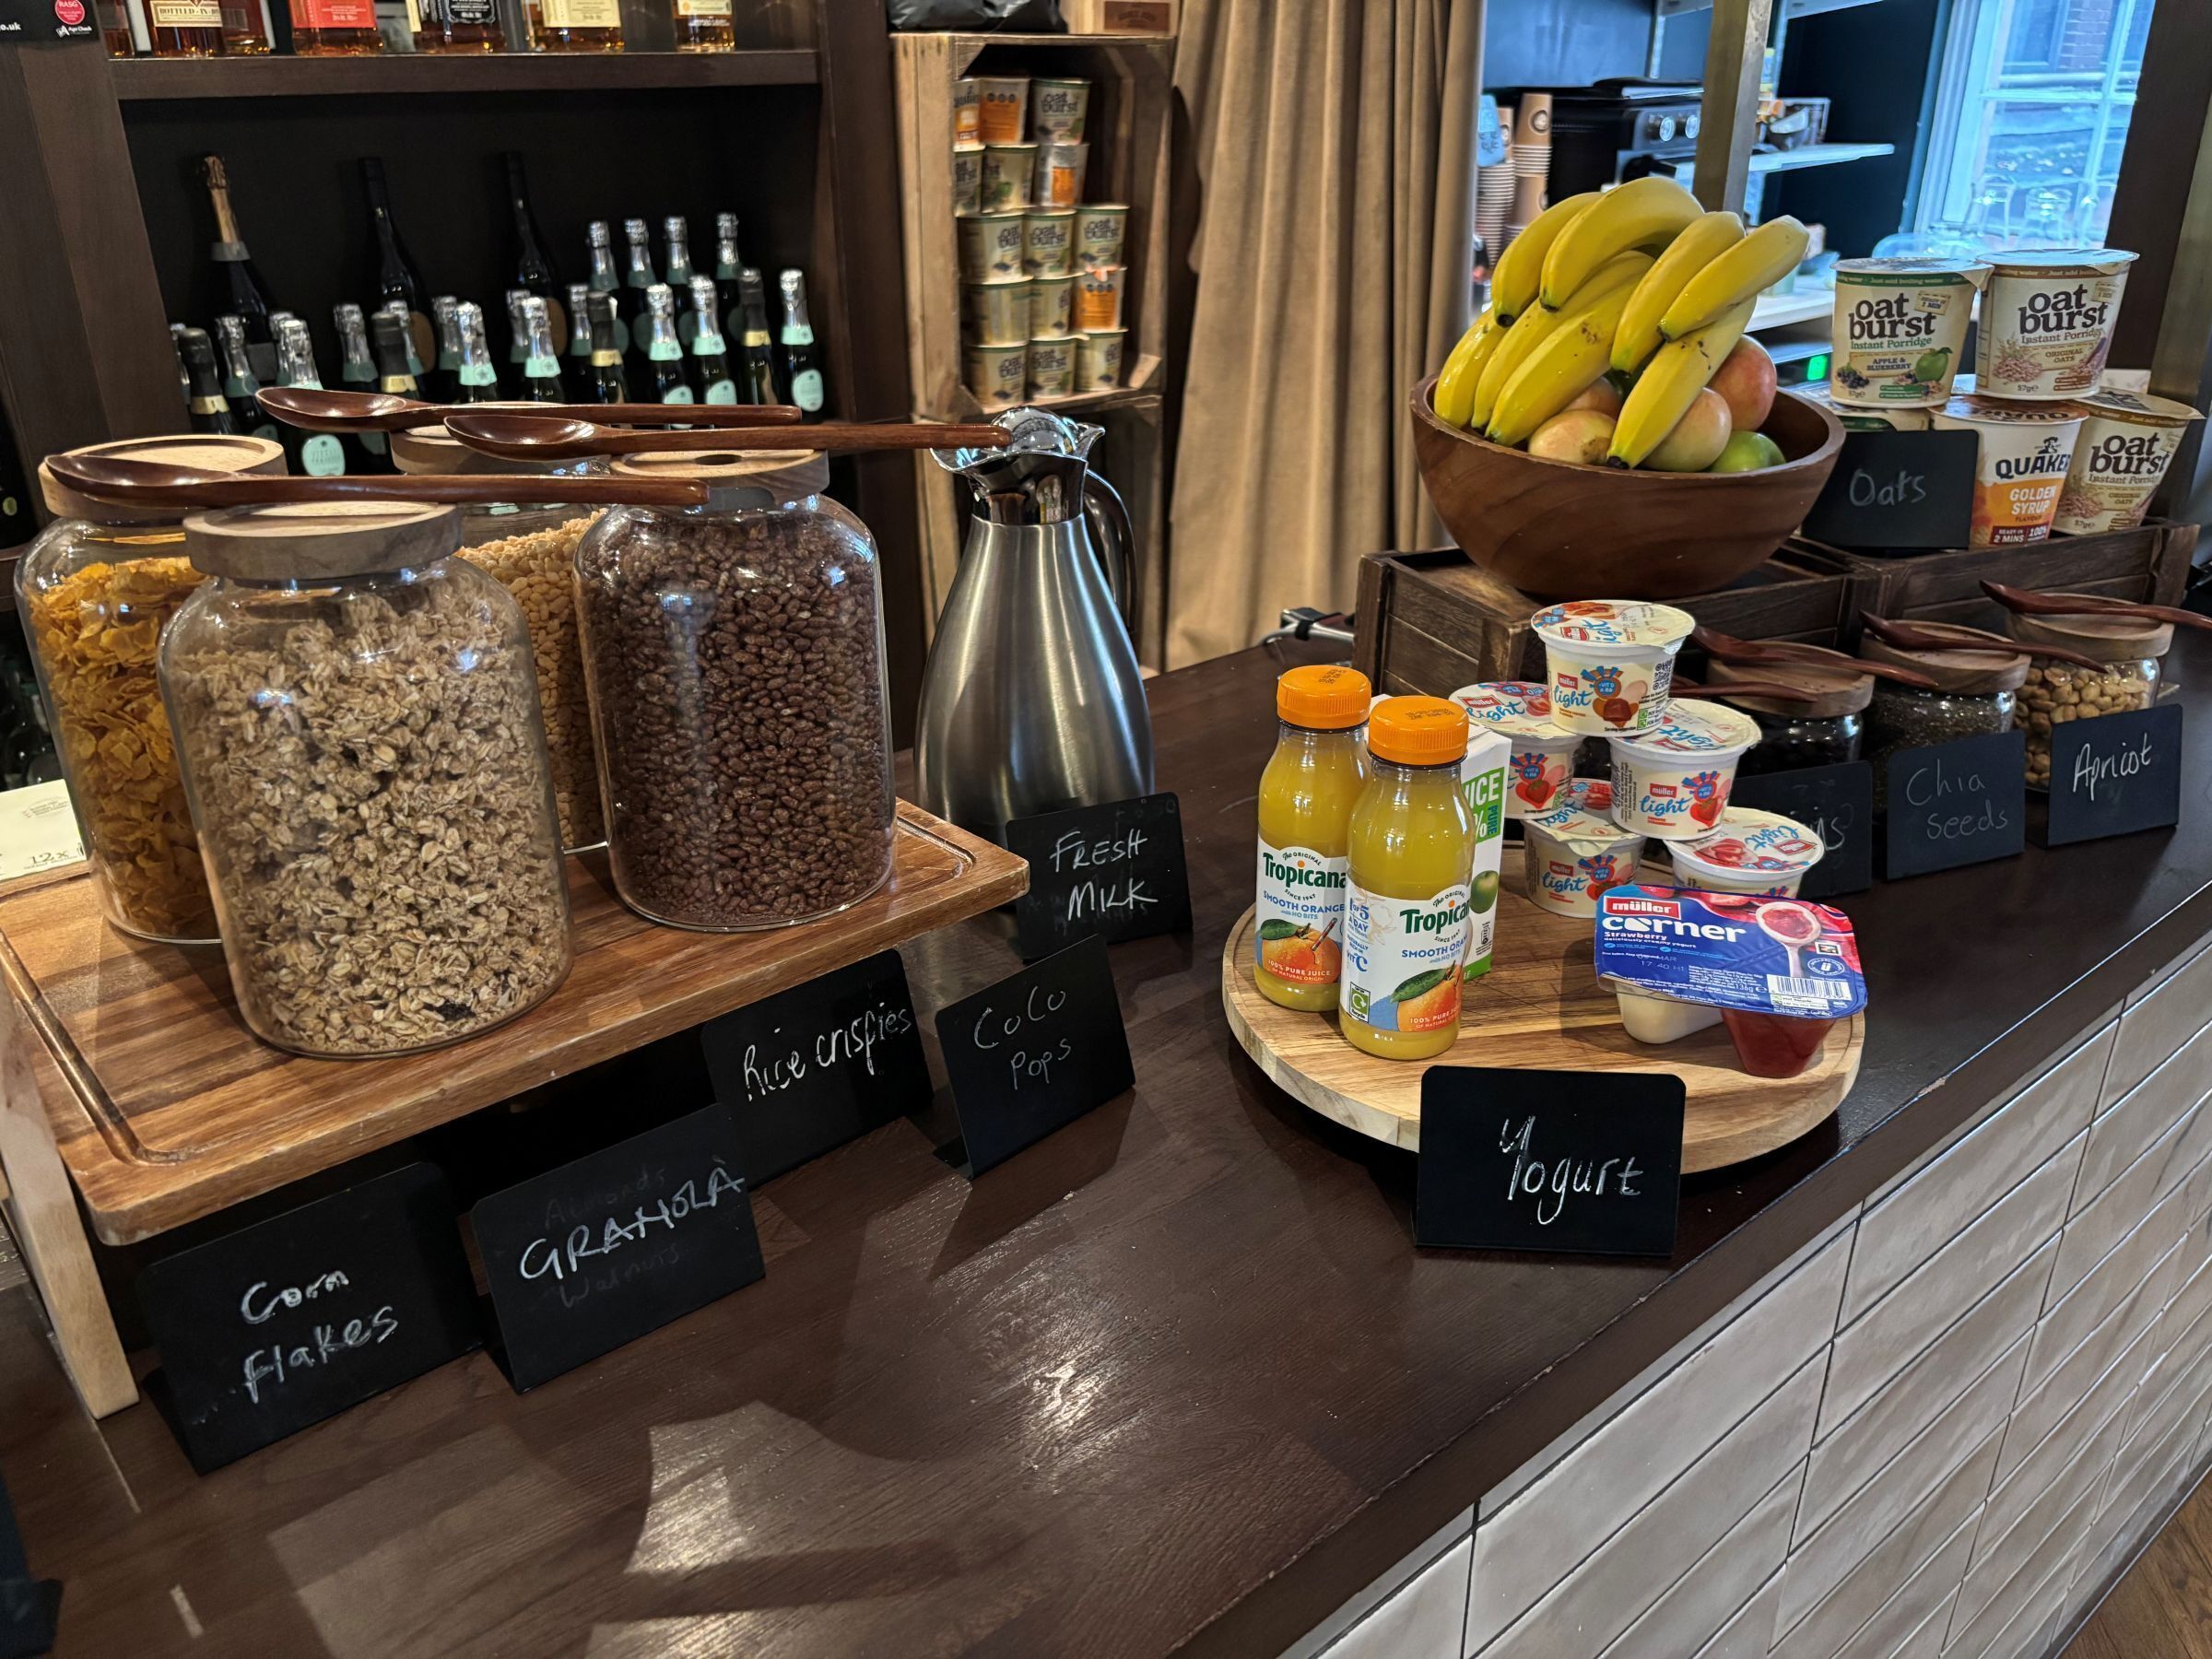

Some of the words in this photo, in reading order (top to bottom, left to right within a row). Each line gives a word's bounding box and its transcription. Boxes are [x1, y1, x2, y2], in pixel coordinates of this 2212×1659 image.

[2029, 283, 2088, 313] oat
[1855, 292, 1910, 321] oat
[1848, 312, 1937, 340] burst
[2018, 302, 2108, 335] burst
[1851, 339, 1884, 350] Instant
[1887, 336, 1933, 348] Porridge
[2021, 334, 2061, 345] Instant
[2045, 348, 2083, 358] ORIGINAL
[1866, 362, 1912, 371] BLUEBERRY
[2103, 432, 2160, 456] oat
[2088, 445, 2170, 476] burst
[1849, 467, 1927, 507] Oats
[2088, 474, 2127, 485] Instant
[2009, 485, 2058, 501] GOLDEN
[2011, 500, 2051, 515] SYRUP
[1993, 535, 2001, 544] 2
[2002, 535, 2025, 543] MINS
[1554, 685, 1594, 708] light
[1465, 700, 1525, 722] light
[2072, 733, 2153, 801] Apricot
[1652, 786, 1675, 795] müller
[1906, 759, 1986, 806] Chia
[1640, 794, 1694, 817] light
[1744, 825, 1800, 851] light
[1049, 825, 1149, 873] FRESH
[1282, 852, 1292, 861] The
[1293, 852, 1322, 866] ORIGINAL
[1263, 852, 1347, 888] Tropicana
[1542, 871, 1590, 893] light
[1066, 877, 1159, 922] MILK
[1264, 890, 1299, 911] SMOOTH
[1300, 903, 1346, 913] ORANGE
[1285, 888, 1301, 900] SINCE
[1302, 893, 1316, 901] 1947
[1433, 897, 1444, 908] The
[1291, 911, 1302, 919] NO
[1359, 905, 1370, 921] 5
[1612, 901, 1672, 913] müller
[1353, 919, 1370, 933] DAY
[1602, 916, 1747, 943] corner
[1604, 931, 1667, 940] Strawberry
[1401, 947, 1448, 958] SMOOTH
[1441, 954, 1451, 963] NO
[1268, 959, 1284, 971] 100%
[1285, 966, 1306, 976] PURE
[1355, 956, 1369, 972] C
[1278, 971, 1303, 981] NATURAL
[1735, 982, 1754, 993] 136g
[1410, 1016, 1430, 1024] 100%
[1432, 1012, 1450, 1021] PURE
[1425, 1018, 1447, 1028] NATURAL
[744, 1027, 806, 1102] Rice
[815, 1001, 912, 1077] crispies
[1499, 1115, 1644, 1226] Yogurt
[518, 1163, 747, 1282] GRANOLA
[241, 1269, 350, 1324] Corn
